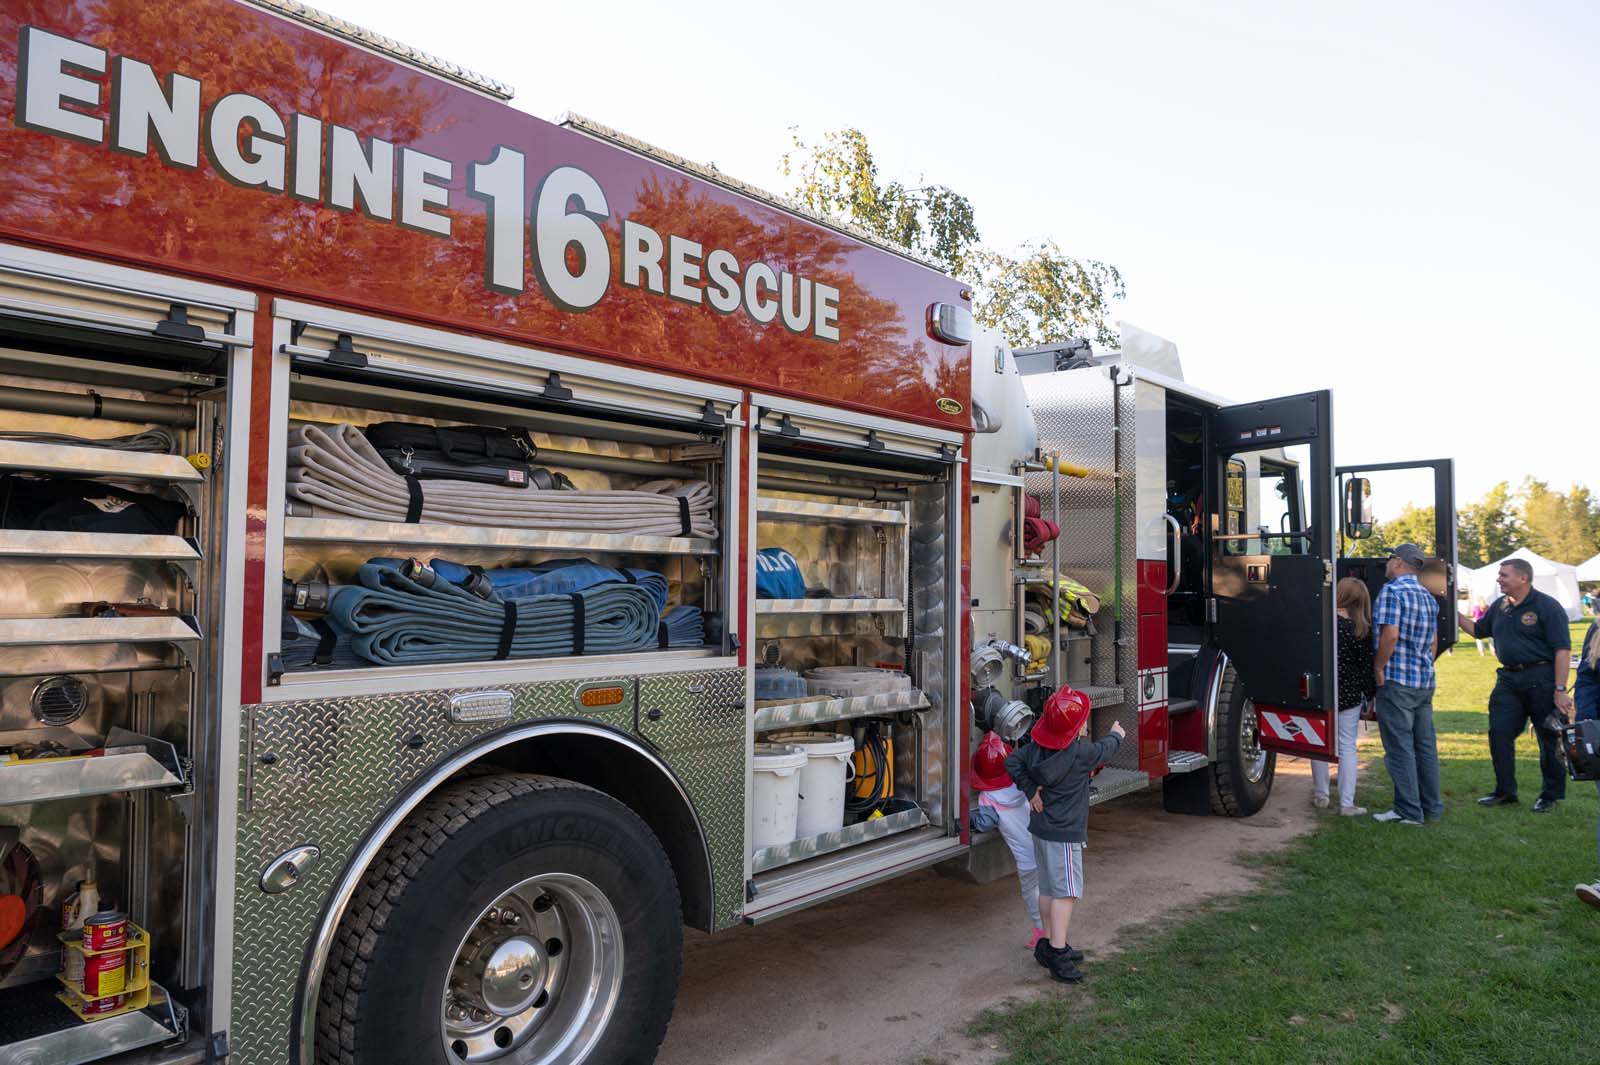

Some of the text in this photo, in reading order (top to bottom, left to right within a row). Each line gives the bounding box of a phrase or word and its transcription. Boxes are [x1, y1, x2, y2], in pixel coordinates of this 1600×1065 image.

[15, 24, 841, 342] ENGINE 16 RESCUE
